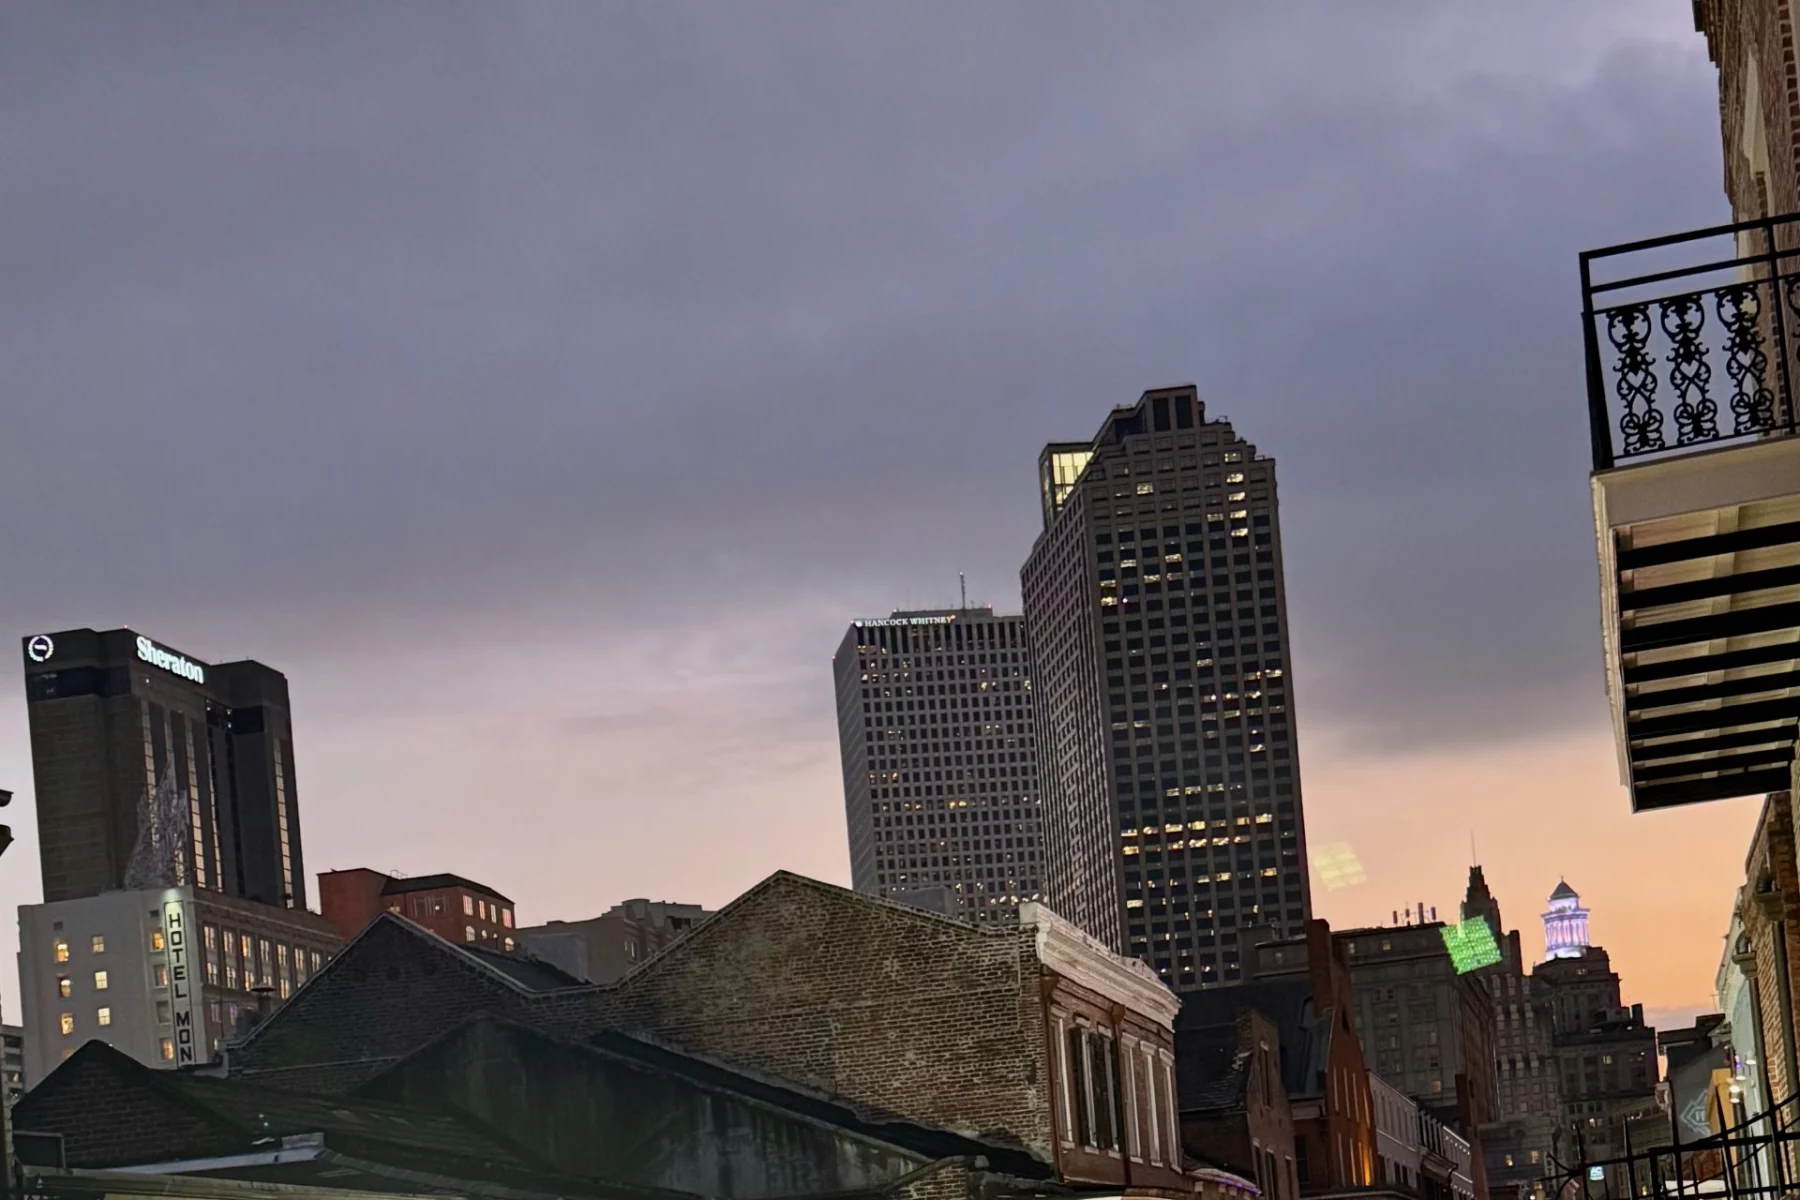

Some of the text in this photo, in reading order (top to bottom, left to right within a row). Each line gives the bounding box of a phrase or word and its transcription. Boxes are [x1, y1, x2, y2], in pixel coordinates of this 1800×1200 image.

[864, 615, 951, 627] HANCOCK WHITNEY
[136, 636, 204, 685] Sheraton
[168, 912, 193, 1062] HOTEL MON
